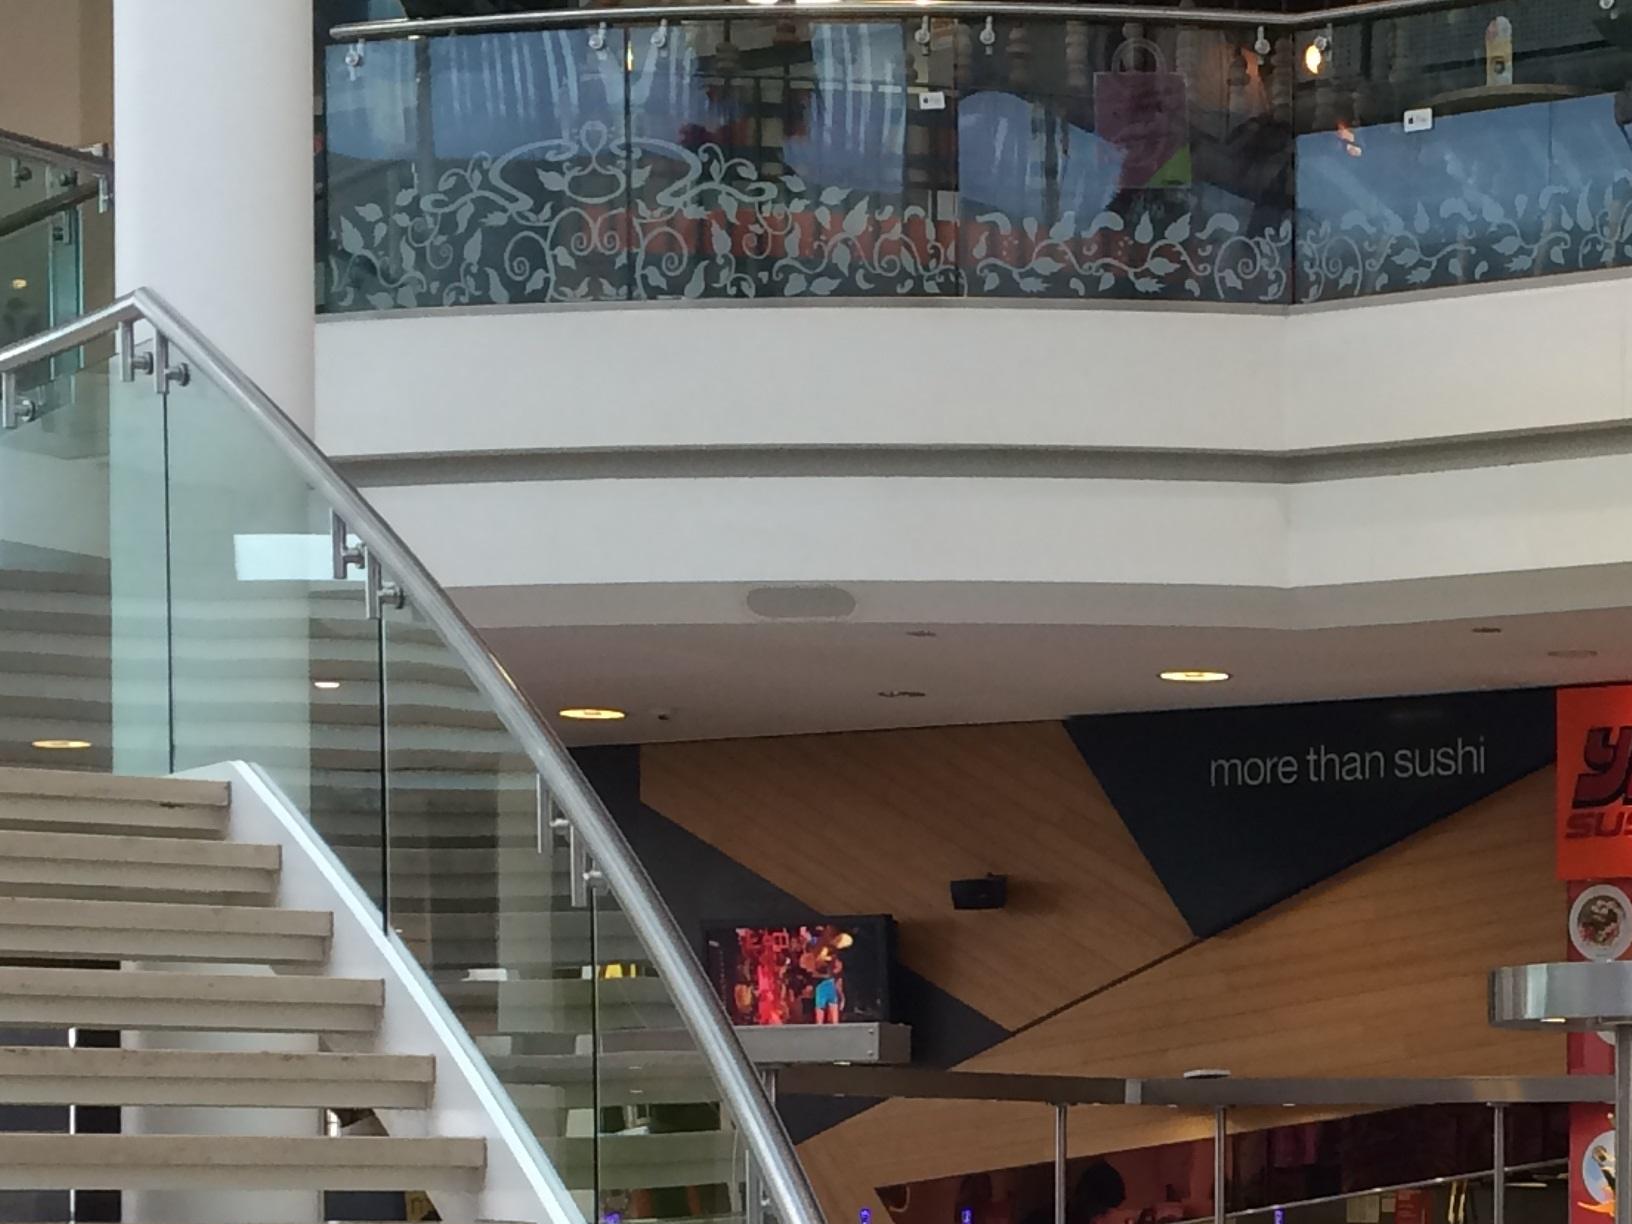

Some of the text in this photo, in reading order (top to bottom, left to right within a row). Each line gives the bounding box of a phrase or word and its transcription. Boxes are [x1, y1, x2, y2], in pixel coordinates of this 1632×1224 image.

[1210, 736, 1485, 787] more than sushi
